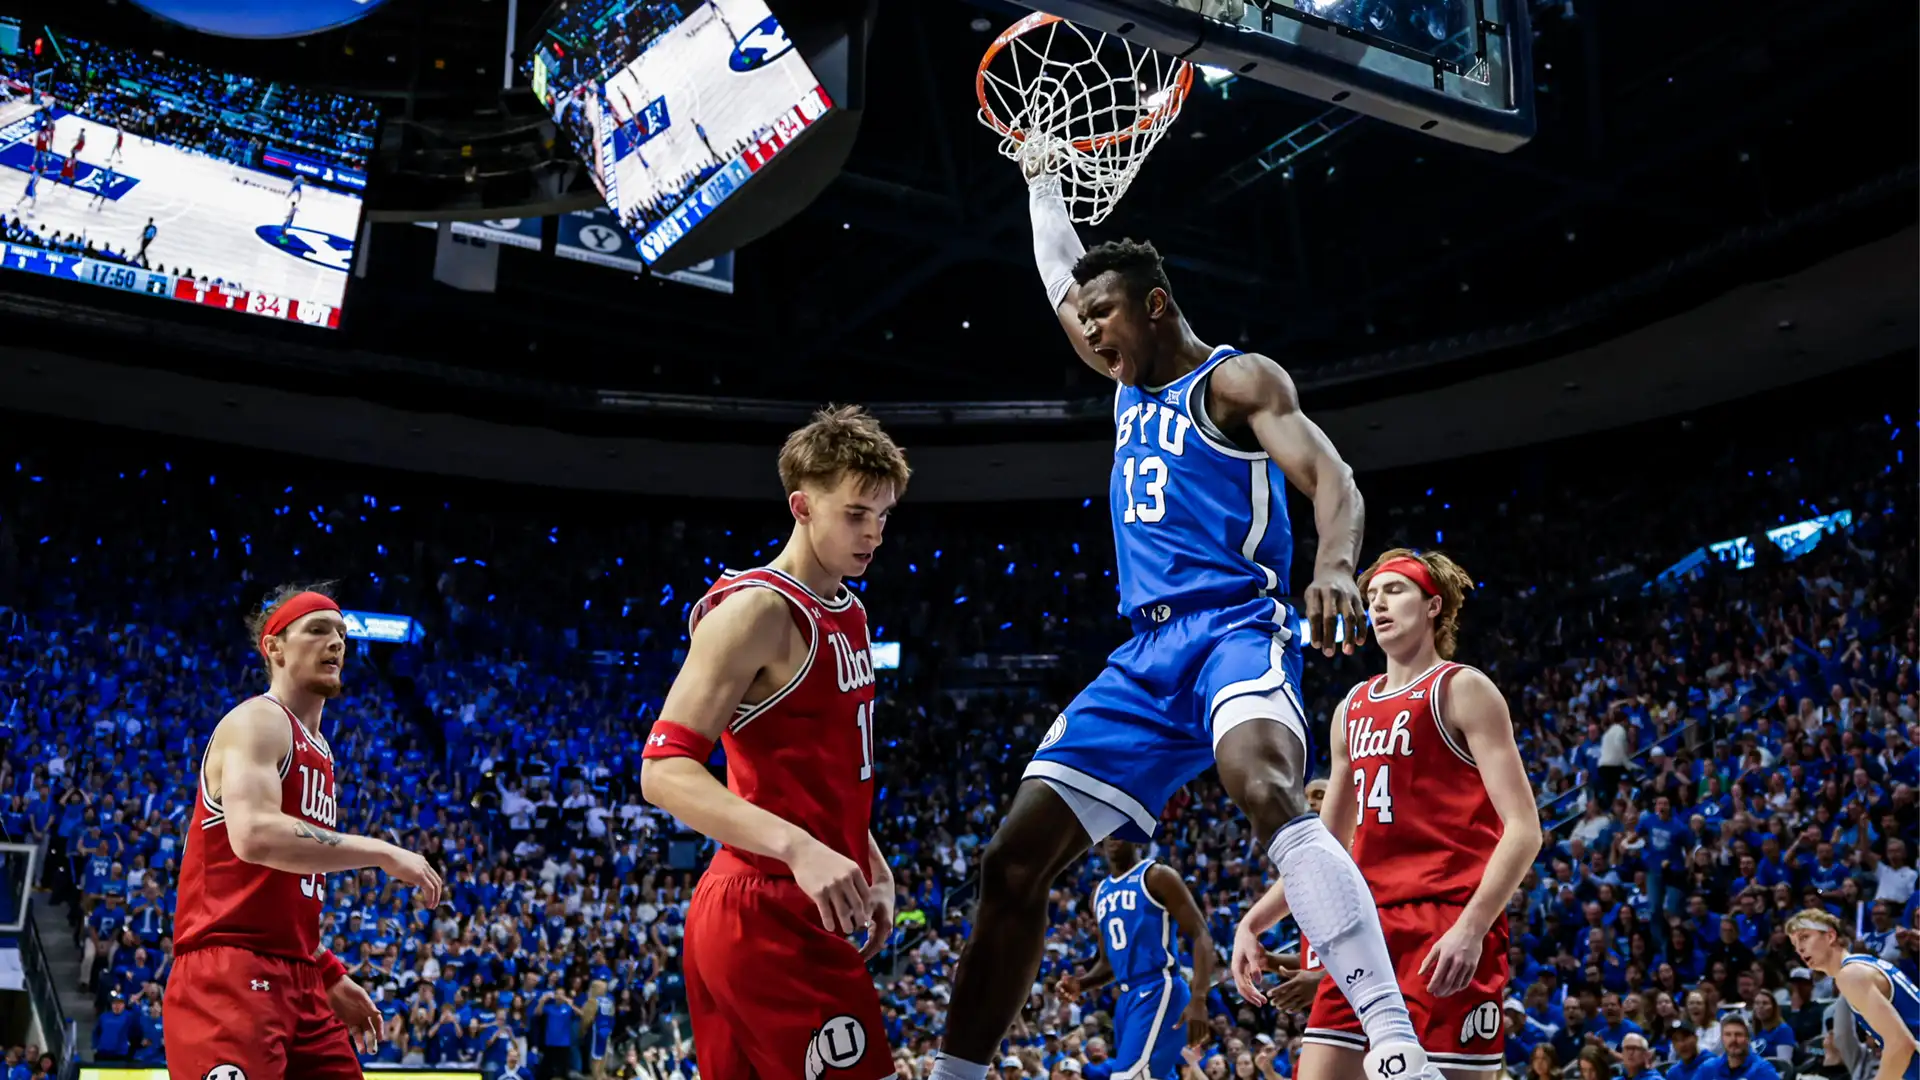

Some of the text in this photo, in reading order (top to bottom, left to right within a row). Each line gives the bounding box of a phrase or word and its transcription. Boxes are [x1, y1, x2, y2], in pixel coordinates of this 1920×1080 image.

[91, 263, 136, 289] 17:50
[255, 294, 280, 316] 34
[1116, 402, 1191, 456] BYU
[1123, 456, 1168, 524] 13
[857, 700, 875, 781] 1
[1349, 711, 1413, 761] Utah
[1353, 765, 1393, 825] 34
[1097, 890, 1137, 922] BYU
[1108, 917, 1127, 950] 0
[823, 1021, 858, 1062] U
[1480, 1008, 1498, 1034] U
